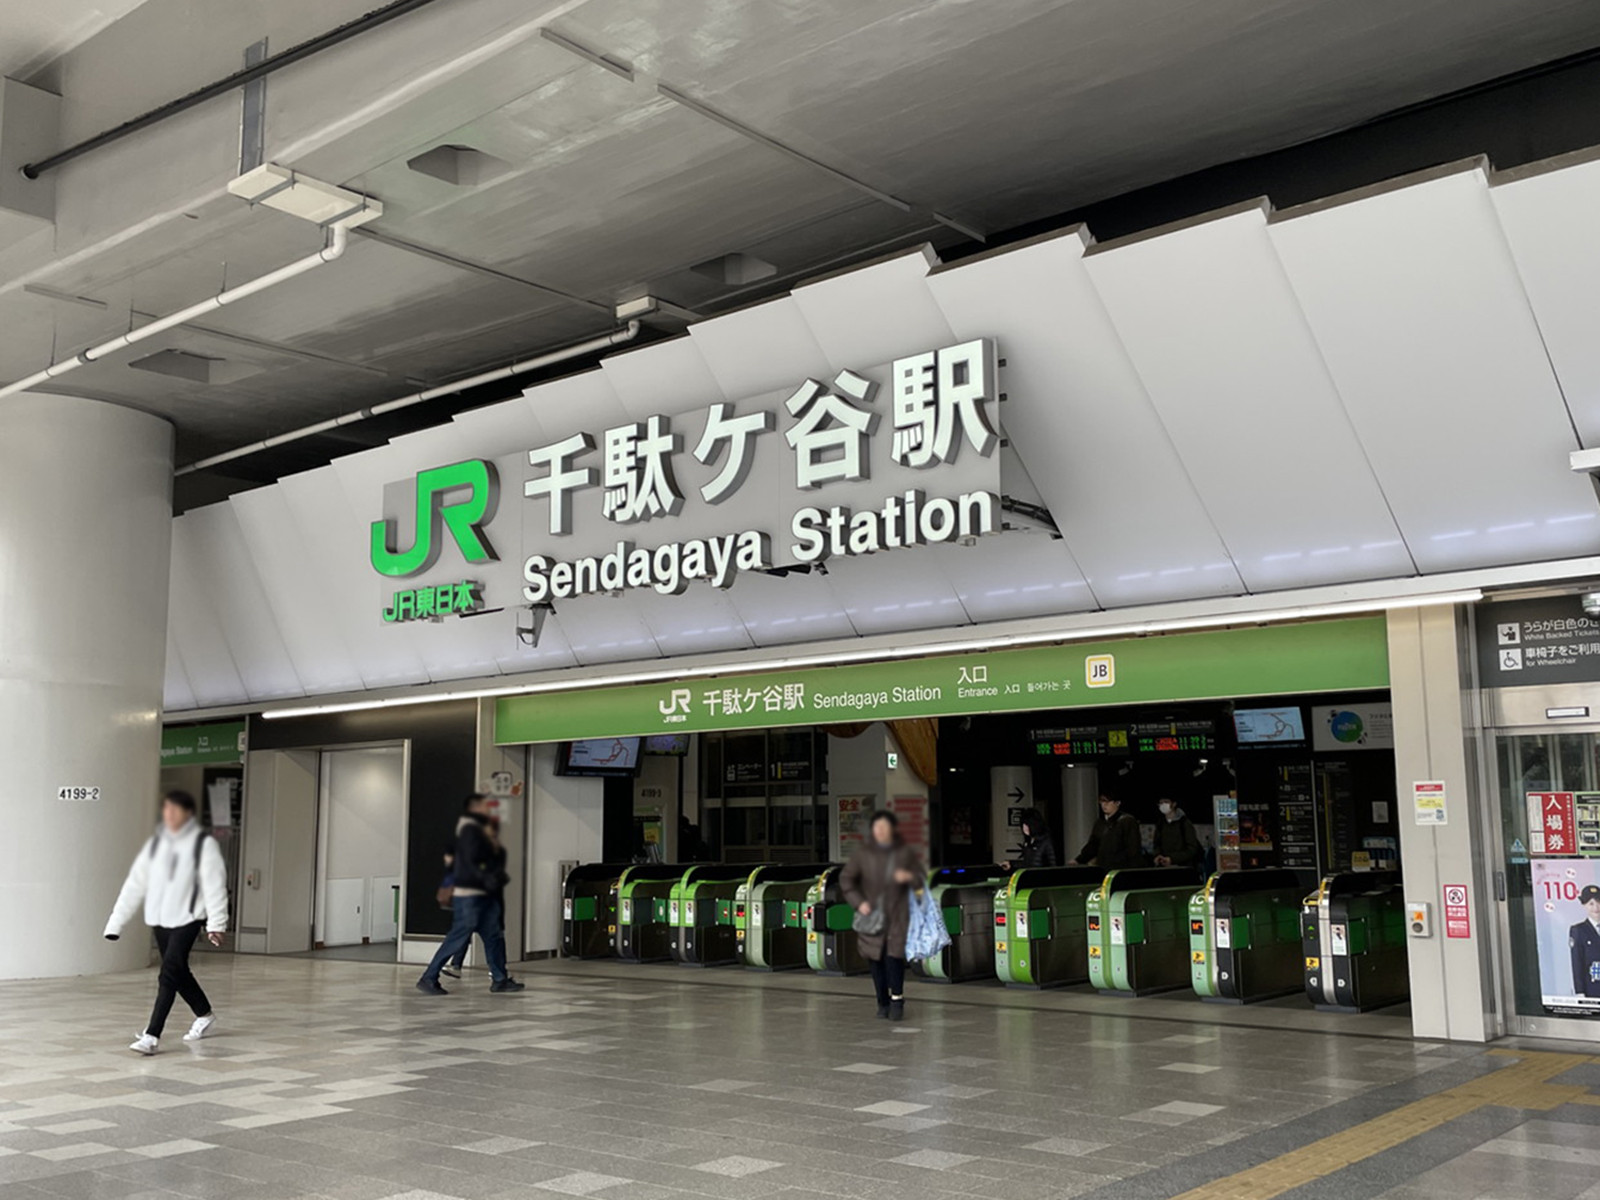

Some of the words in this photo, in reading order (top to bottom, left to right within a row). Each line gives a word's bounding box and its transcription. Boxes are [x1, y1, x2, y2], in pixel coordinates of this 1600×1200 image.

[524, 338, 1000, 536] 千駄ケ谷駅
[370, 458, 498, 577] JR
[522, 530, 770, 602] Sendagaya
[790, 489, 994, 562] Station
[382, 580, 480, 623] JR東日本
[1524, 633, 1545, 641] White
[1545, 631, 1573, 639] Backed
[957, 665, 989, 684] 入口
[1092, 664, 1108, 678] JB
[658, 688, 692, 715] JR
[702, 683, 805, 716] 千駄ケ谷駅
[813, 691, 888, 710] Sendagaya
[892, 686, 941, 703] Station
[957, 687, 998, 698] Entrance
[59, 787, 100, 800] 4199-2
[1545, 795, 1565, 851] 入場券
[1087, 892, 1101, 901] IC
[1190, 895, 1205, 905] IC
